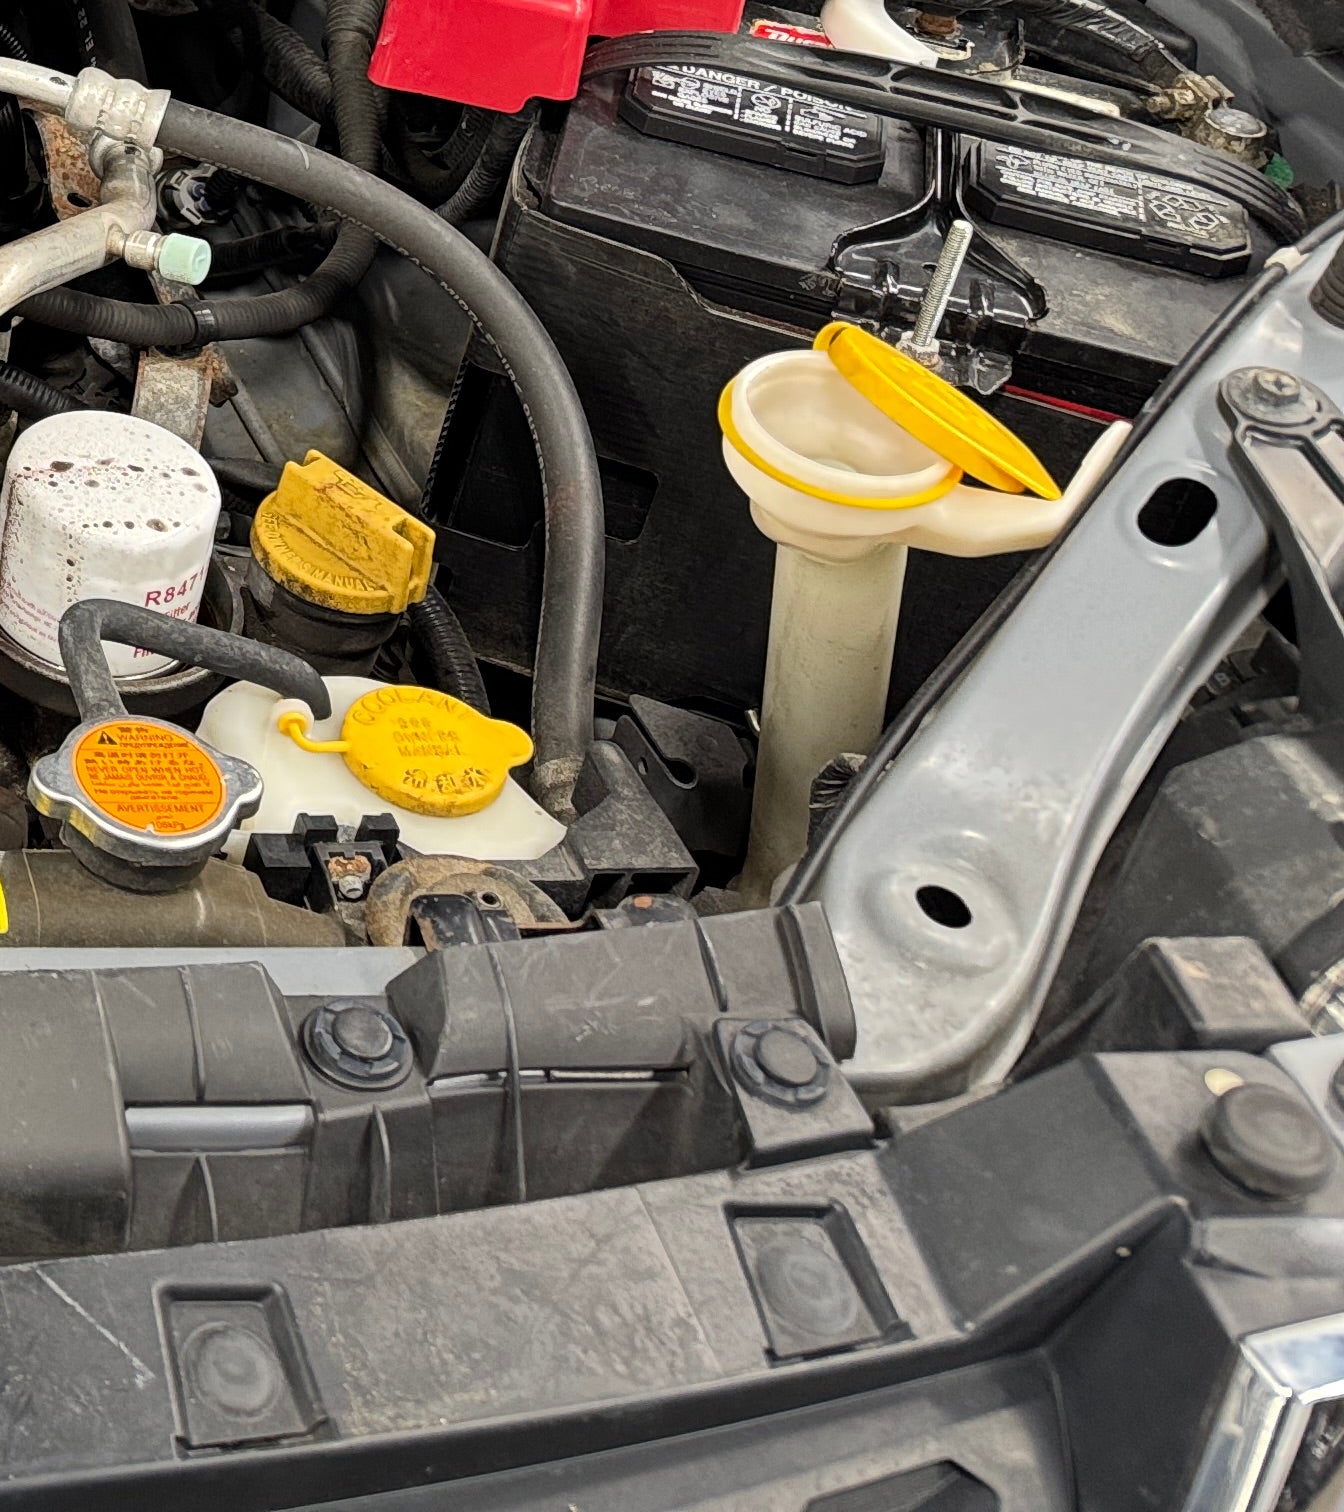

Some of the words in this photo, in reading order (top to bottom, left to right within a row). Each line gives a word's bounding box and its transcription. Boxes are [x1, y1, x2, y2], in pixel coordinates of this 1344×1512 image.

[681, 64, 761, 90] DANGER
[311, 567, 376, 592] MANUAL
[353, 689, 474, 726] COOLANT
[116, 734, 174, 742] WARNING
[116, 804, 205, 813] AVERTISSEMENT
